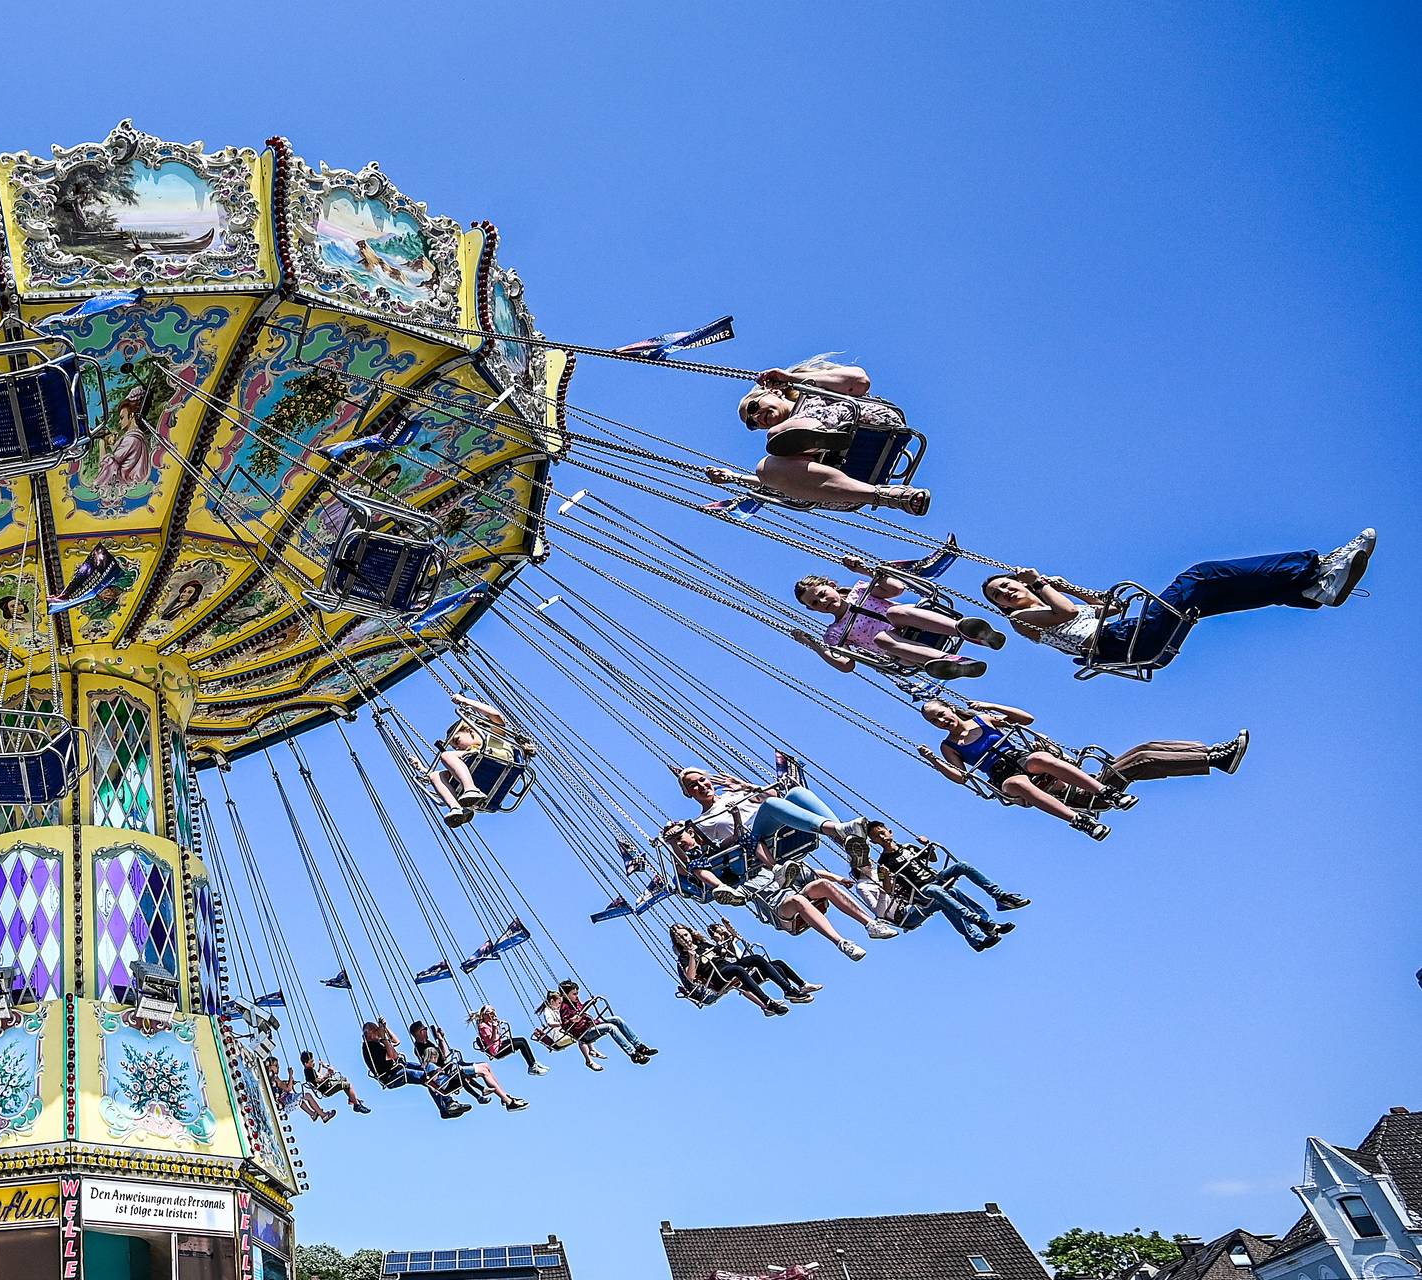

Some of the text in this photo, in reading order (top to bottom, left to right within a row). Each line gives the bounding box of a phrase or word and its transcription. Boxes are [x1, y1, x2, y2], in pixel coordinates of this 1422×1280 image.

[90, 1187, 226, 1210] Den Anweisungen des Personals
[115, 1203, 128, 1214] ist
[130, 1204, 151, 1218] folge
[153, 1208, 164, 1217] zu
